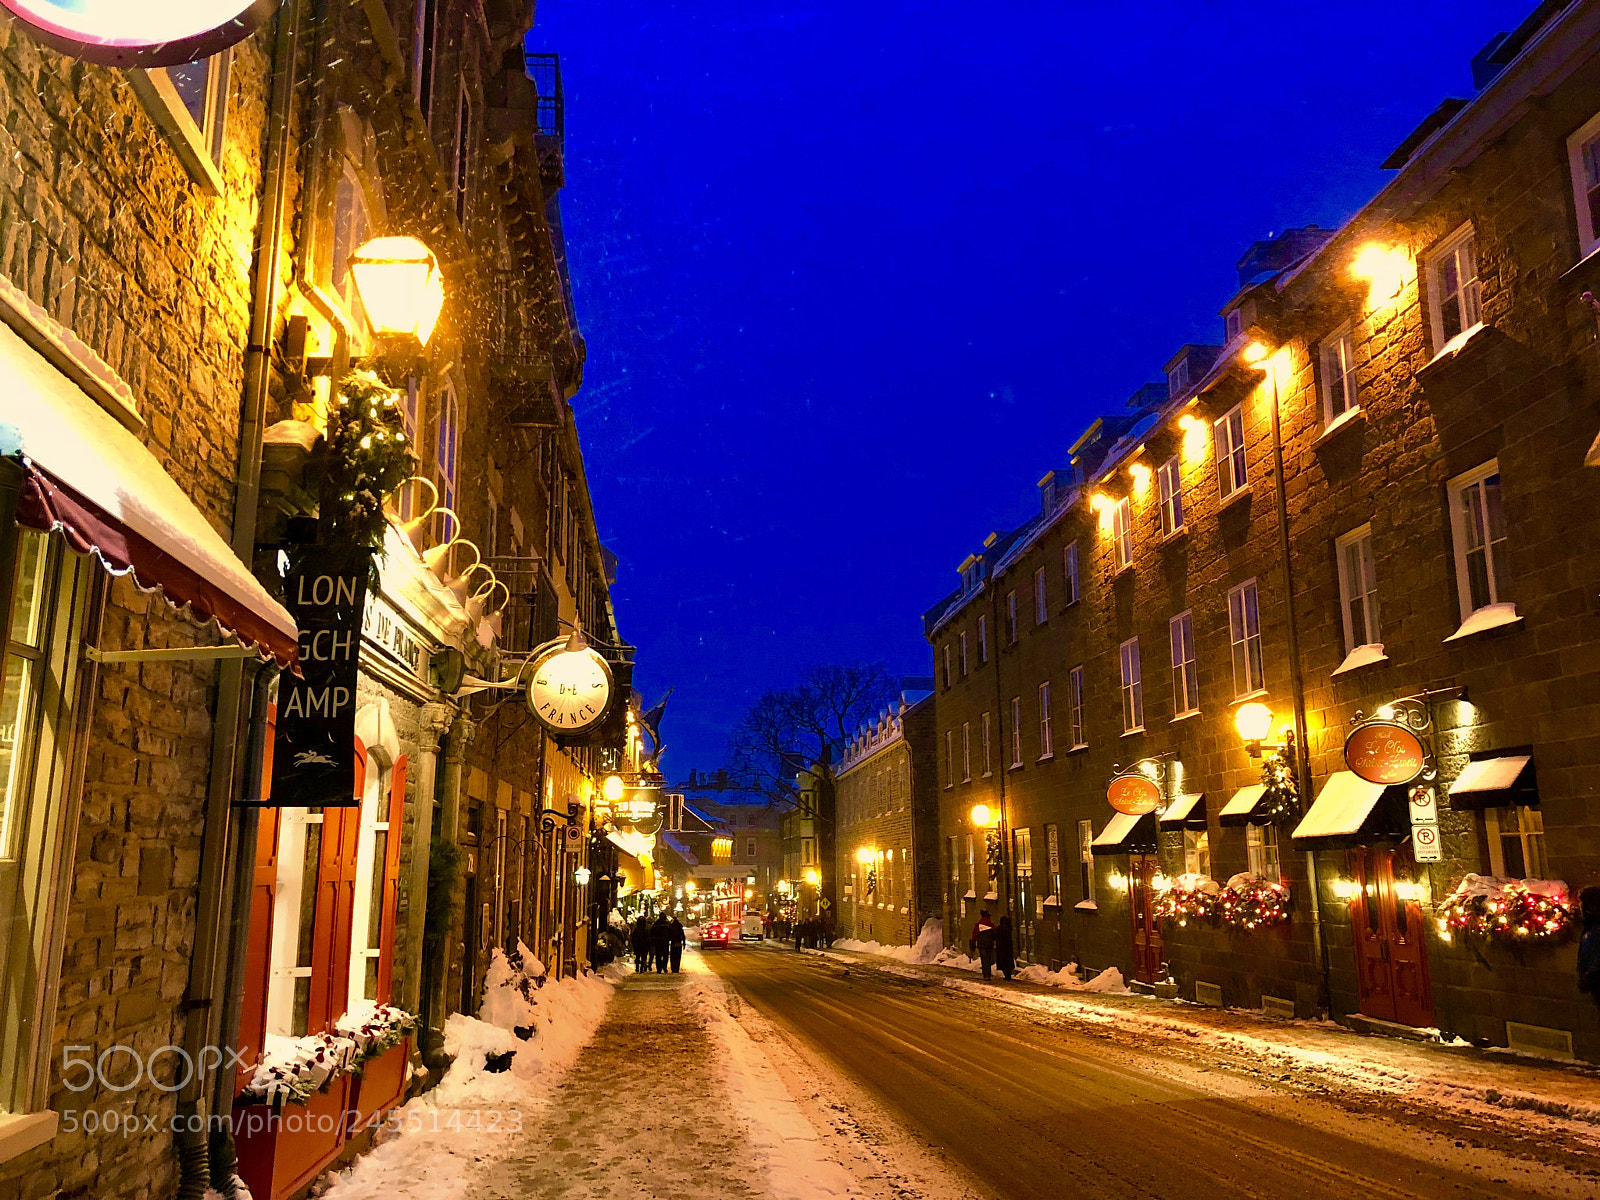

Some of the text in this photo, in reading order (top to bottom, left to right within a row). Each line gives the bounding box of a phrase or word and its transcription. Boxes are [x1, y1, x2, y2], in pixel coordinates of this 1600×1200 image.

[297, 575, 357, 606] LON
[376, 611, 391, 645] DE
[297, 630, 352, 661] GCH
[284, 686, 350, 718] AMP
[540, 702, 596, 724] FRANCE
[1366, 740, 1406, 754] Le Clos
